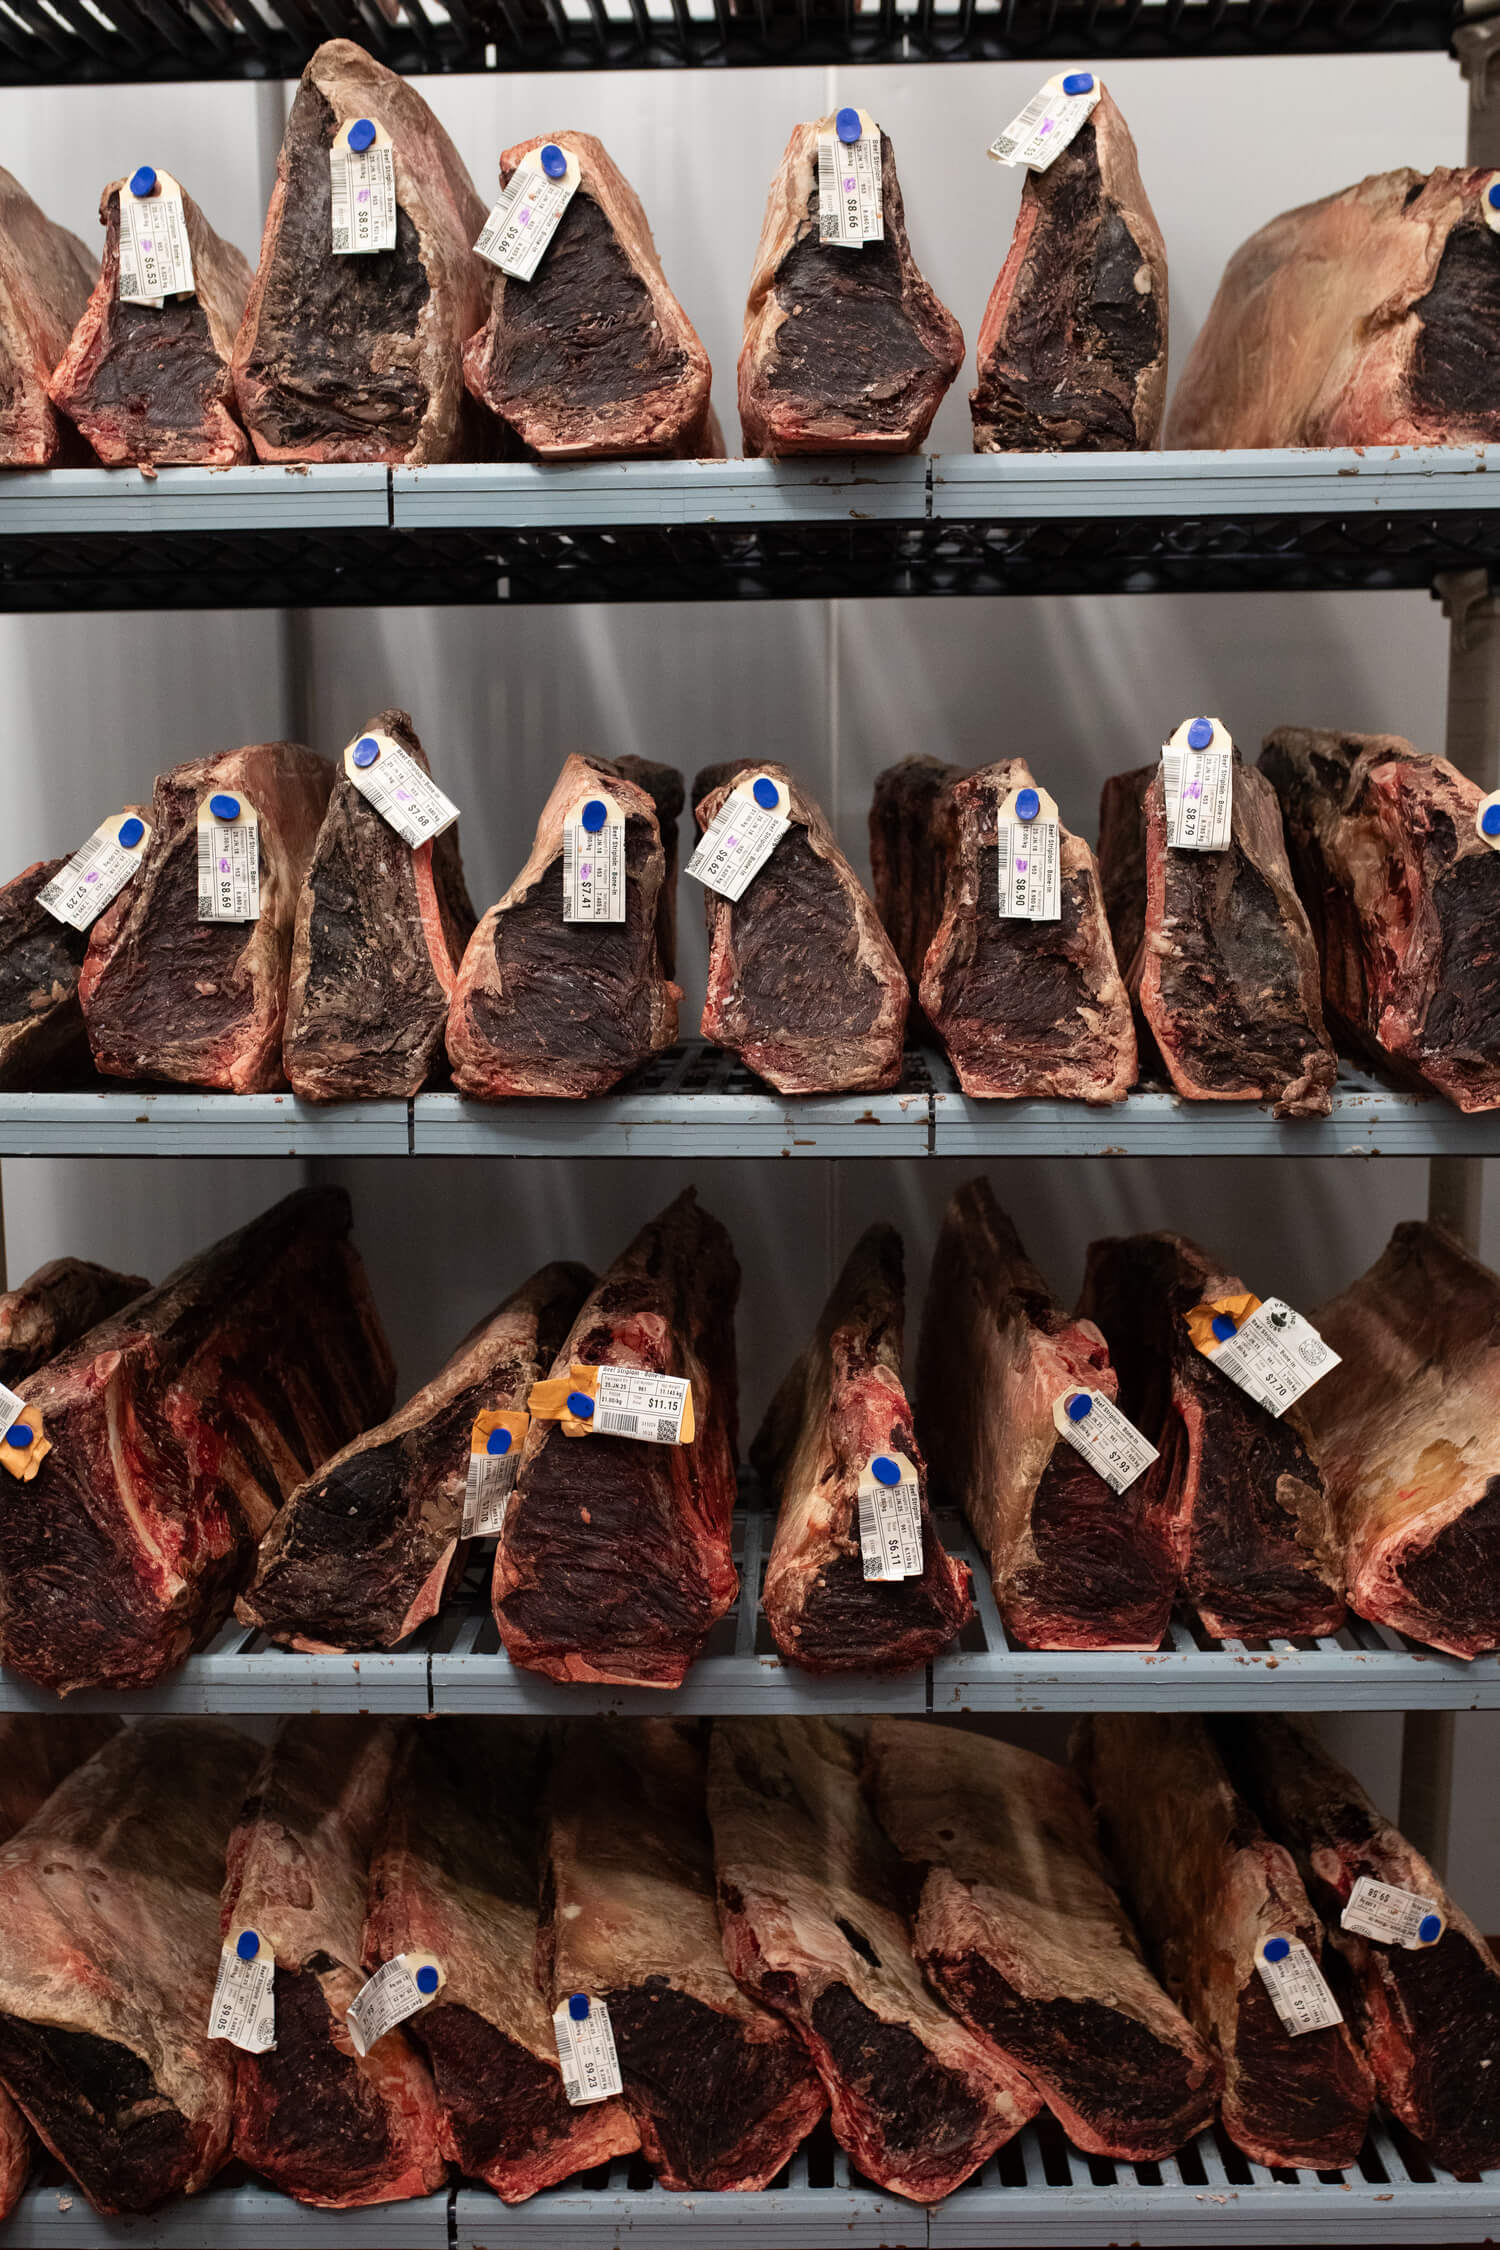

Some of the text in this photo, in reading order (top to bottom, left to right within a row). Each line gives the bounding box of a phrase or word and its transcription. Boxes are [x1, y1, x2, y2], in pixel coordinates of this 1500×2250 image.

[358, 211, 368, 238] $8.93
[847, 199, 857, 228] $8.66
[497, 225, 518, 253] $9.66
[144, 256, 156, 285] $6.53
[1218, 769, 1226, 794] Striploin
[407, 803, 429, 827] $7.68
[1184, 807, 1196, 835] $8.79
[707, 848, 728, 875] $8.62
[739, 855, 756, 876] Bone-in
[64, 885, 87, 910] $7.29
[221, 881, 231, 907] $8.69
[582, 882, 590, 908] $7.41
[1016, 879, 1025, 905] $8.90
[1264, 1372, 1287, 1396] $7.70
[648, 1397, 678, 1410] $11.15
[1093, 1396, 1105, 1409] Beef
[1102, 1406, 1121, 1426] Striploin
[1121, 1426, 1140, 1444] Bone-in
[1108, 1450, 1131, 1473] $7.93
[887, 1539, 900, 1565] $6.11
[1367, 1887, 1390, 1903] $9.58
[216, 2003, 232, 2030] $9.05
[1293, 1999, 1311, 2023] $7.19
[584, 2062, 597, 2088] $9.23
